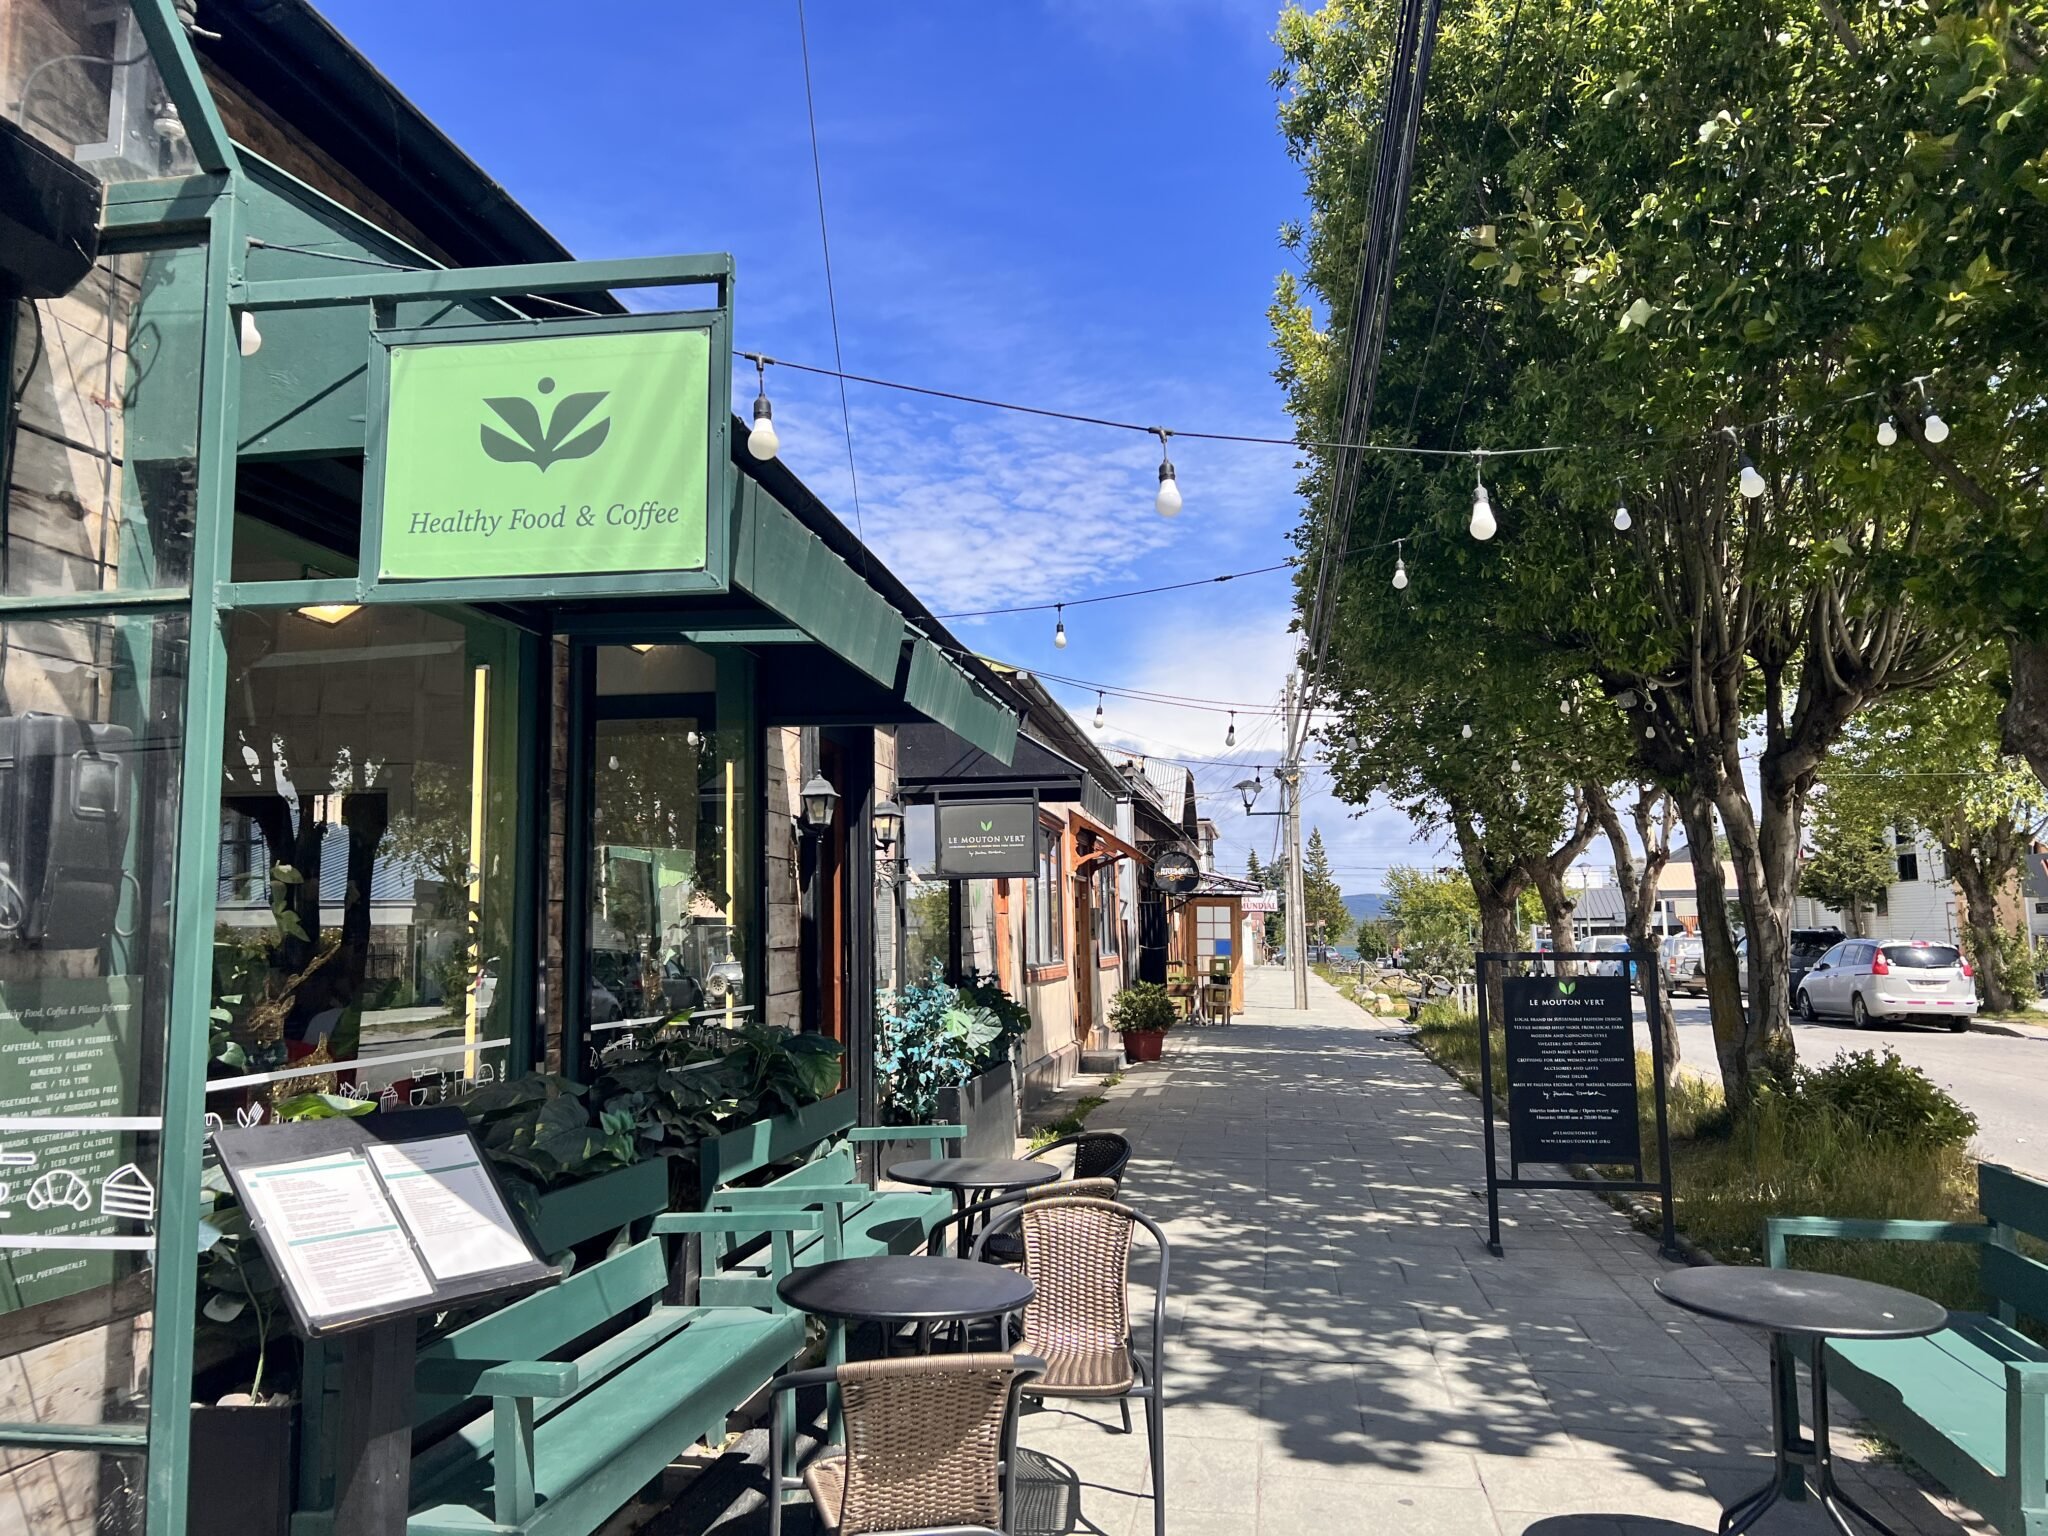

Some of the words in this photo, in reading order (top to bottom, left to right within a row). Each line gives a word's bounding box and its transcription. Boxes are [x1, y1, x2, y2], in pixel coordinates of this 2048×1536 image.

[408, 508, 502, 537] Healthy
[508, 505, 566, 530] Food
[576, 504, 595, 527] &
[606, 500, 680, 531] Coffee
[46, 1006, 68, 1018] Coffee
[47, 1038, 75, 1048] TETERÍA
[18, 1054, 55, 1064] DESAYUNOS
[65, 1048, 103, 1060] BREAKFASTS
[30, 1066, 62, 1077] ALMUERZO
[72, 1063, 92, 1072] LUNCH
[30, 1081, 47, 1090] ONCE
[74, 1076, 89, 1084] TIME
[46, 1092, 66, 1101] VEGAN
[77, 1088, 100, 1098] GLUTEN
[103, 1085, 117, 1094] FREE
[31, 1108, 52, 1117] MADRE
[63, 1101, 98, 1112] SOURDOUGH
[100, 1098, 119, 1107] BREAD
[44, 1143, 80, 1156] CHOCOLATE
[83, 1136, 113, 1148] CALIENTE
[50, 1158, 67, 1168] ICED
[70, 1153, 92, 1164] COFFEE
[96, 1149, 115, 1159] CREAM
[89, 1165, 101, 1173] PIE
[79, 1216, 109, 1228] DELIVERY
